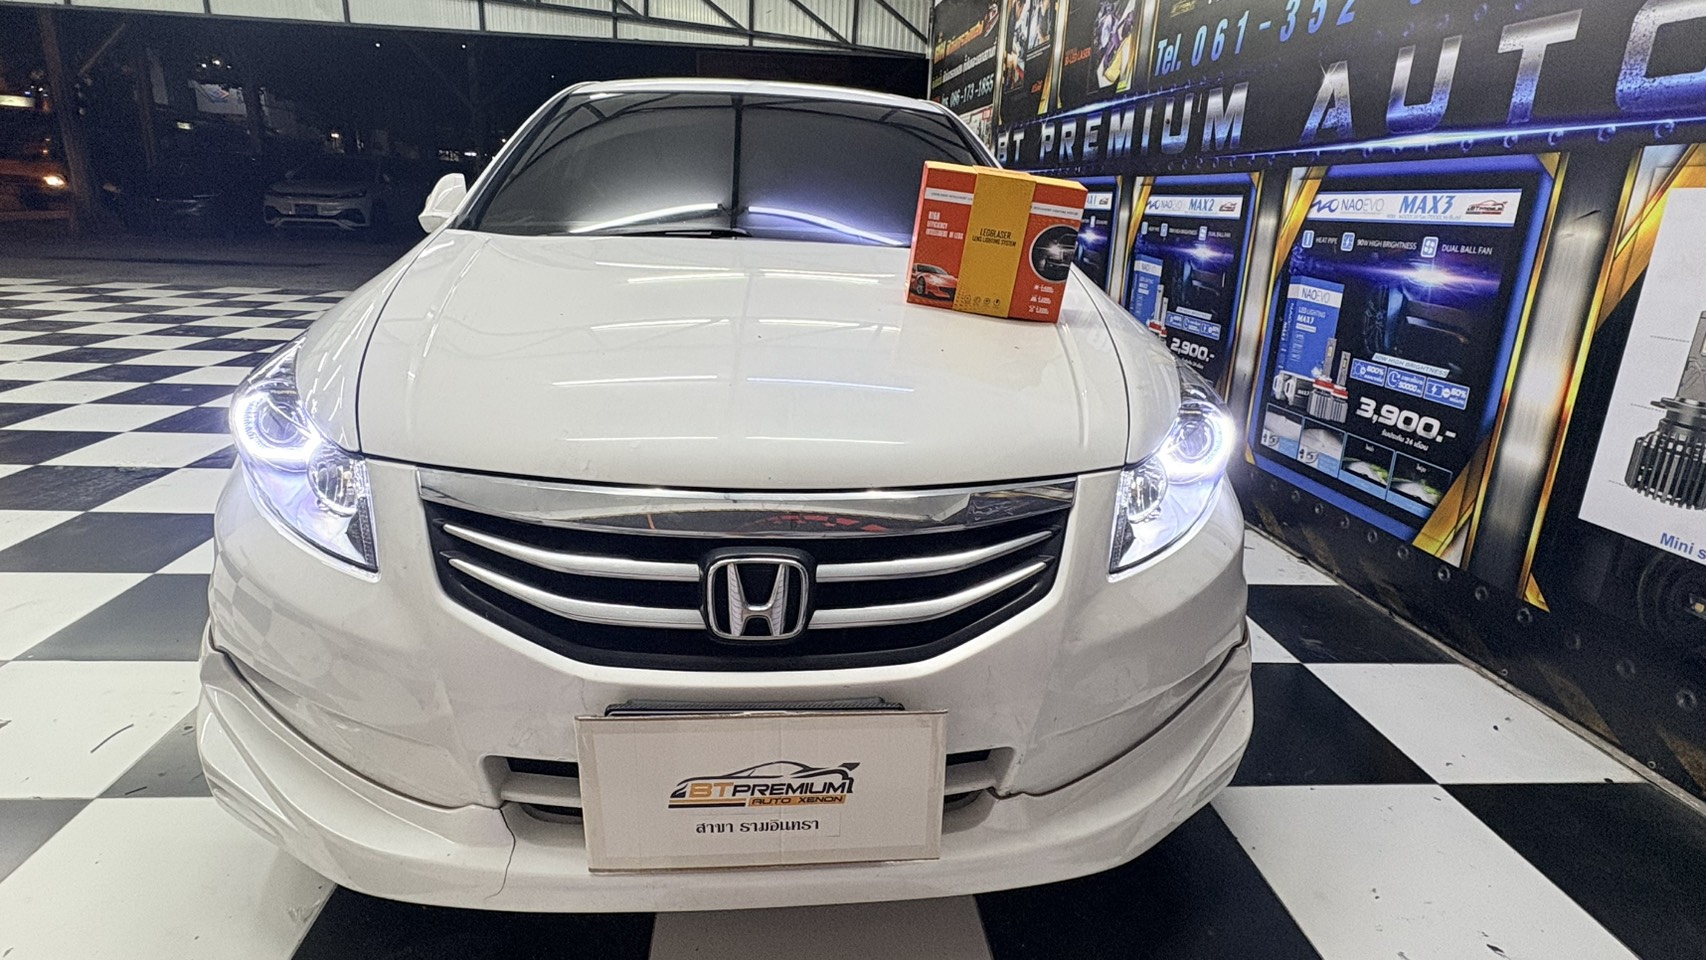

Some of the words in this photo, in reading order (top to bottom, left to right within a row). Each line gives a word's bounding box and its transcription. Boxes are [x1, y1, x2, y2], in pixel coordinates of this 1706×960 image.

[1155, 34, 1181, 77] Tel.
[998, 128, 1025, 164] BT
[1040, 82, 1249, 161] PREMIUM
[1189, 198, 1215, 212] MAX2
[1341, 198, 1385, 212] NAOEVO
[1399, 195, 1456, 214] MAX3
[1369, 240, 1383, 248] HIGH
[1383, 240, 1418, 250] BRIGHTNESS
[1442, 244, 1460, 252] DUAL
[1461, 245, 1477, 254] BALL
[1478, 246, 1493, 255] FAN
[1170, 337, 1215, 362] 2,900.-
[1405, 360, 1448, 377] BRIGHTNESS
[1355, 396, 1457, 443] 3,900.-
[1404, 437, 1413, 446] 24
[1659, 532, 1694, 556] Mini
[752, 797, 792, 806] AUTO
[798, 796, 844, 804] XENON
[696, 821, 734, 834] สาขา
